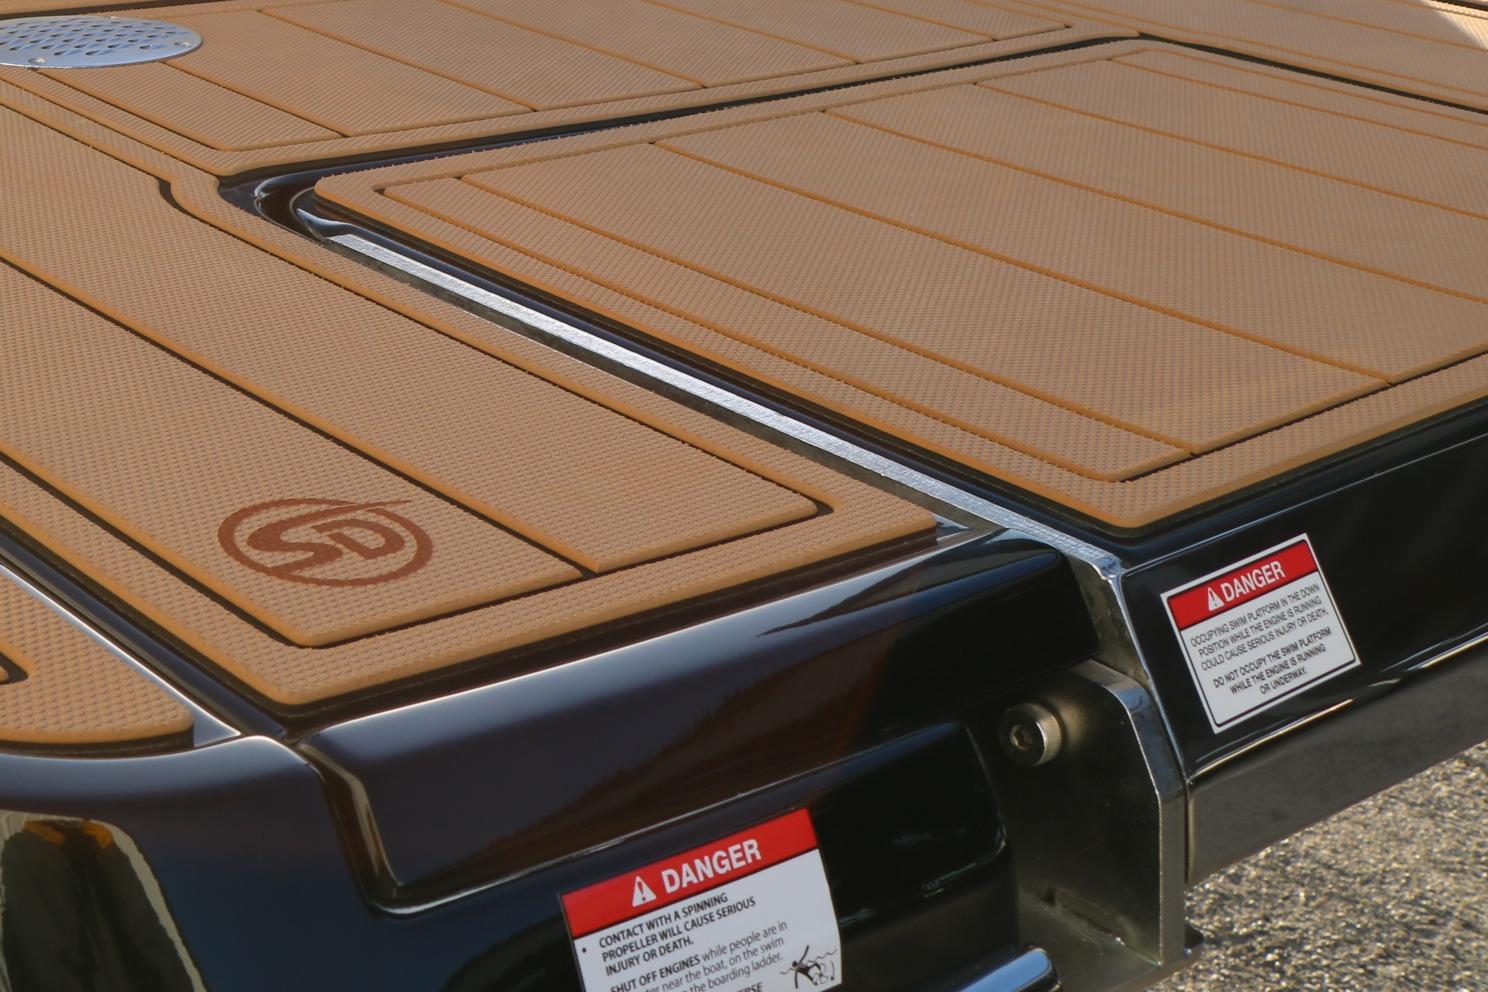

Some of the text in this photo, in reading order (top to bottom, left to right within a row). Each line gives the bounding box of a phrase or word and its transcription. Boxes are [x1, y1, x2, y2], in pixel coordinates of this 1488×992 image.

[1221, 560, 1286, 602] DANGER
[1191, 583, 1320, 648] OCCUPYING SWIM PLATFORM IN THE DOWN
[1198, 596, 1322, 657] POSITION WHILE THE ENGINE IS RUNNING
[1201, 654, 1225, 671] COULD
[1225, 644, 1248, 660] CAUSE
[1247, 630, 1275, 650] SERIOUS
[1274, 621, 1297, 637] INJURY
[1297, 616, 1307, 627] OR
[1213, 626, 1332, 688] DO NOT OCCUPY THE SWIM PLATFORM
[1230, 643, 1326, 694] WHILE THE ENGINE IS RUNNING
[1259, 683, 1270, 695] OR
[661, 838, 762, 894] DANGER
[599, 892, 728, 948] CONTACT WITH A SPINNING
[602, 896, 756, 962] PROPELLER WILL CAUSE SERIOUS
[605, 936, 694, 976] INJURY OR DEATH.
[639, 970, 657, 986] OFF
[659, 954, 701, 979] ENGINES
[701, 944, 728, 962] while
[729, 931, 761, 954] people
[762, 925, 777, 939] are
[777, 920, 788, 932] in
[662, 977, 683, 992] near
[685, 970, 702, 983] the
[729, 954, 742, 966] on
[743, 948, 759, 961] the
[760, 937, 785, 953] swim
[707, 965, 751, 989] boarding
[751, 952, 783, 972] ladder.
